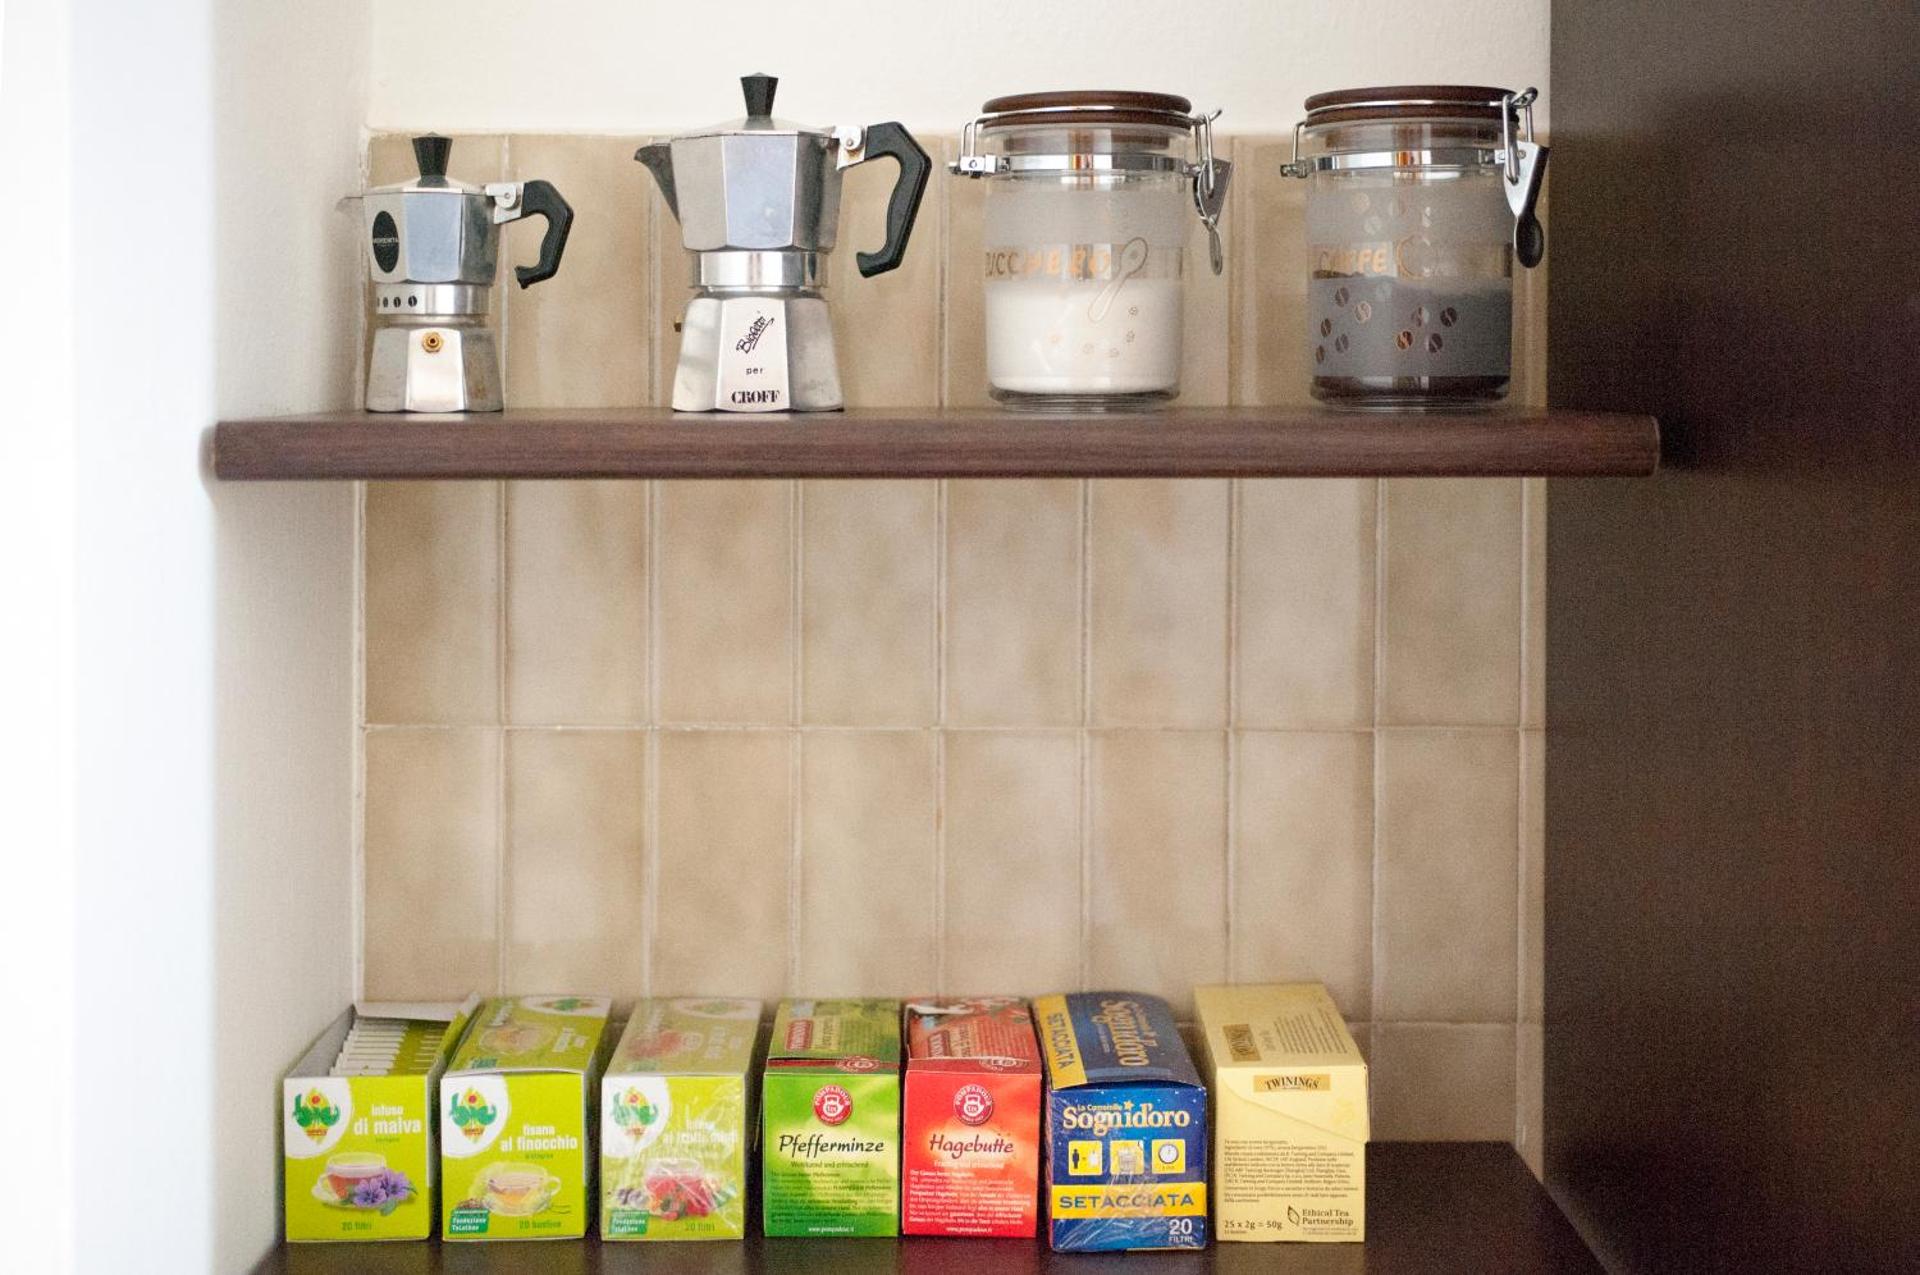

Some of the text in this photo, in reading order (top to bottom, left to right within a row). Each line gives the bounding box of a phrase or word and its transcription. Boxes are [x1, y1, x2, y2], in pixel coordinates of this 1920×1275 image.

[746, 367, 764, 376] per
[731, 390, 781, 404] CROFF
[1264, 1075, 1320, 1091] TWININGS
[353, 1117, 421, 1136] di malva
[500, 1136, 578, 1152] al finocchio
[779, 1133, 885, 1159] Pfefferminze
[929, 1133, 1015, 1160] Hagebutte
[1059, 1193, 1194, 1209] SETACCIATA
[1302, 1209, 1349, 1217] Ethical Tea
[341, 1221, 353, 1231] 20
[519, 1220, 530, 1230] 20
[1168, 1218, 1193, 1235] 20
[1224, 1220, 1235, 1229] 25
[1244, 1220, 1256, 1230] 2g
[1266, 1219, 1283, 1230] 50g
[1302, 1218, 1354, 1228] Partnership
